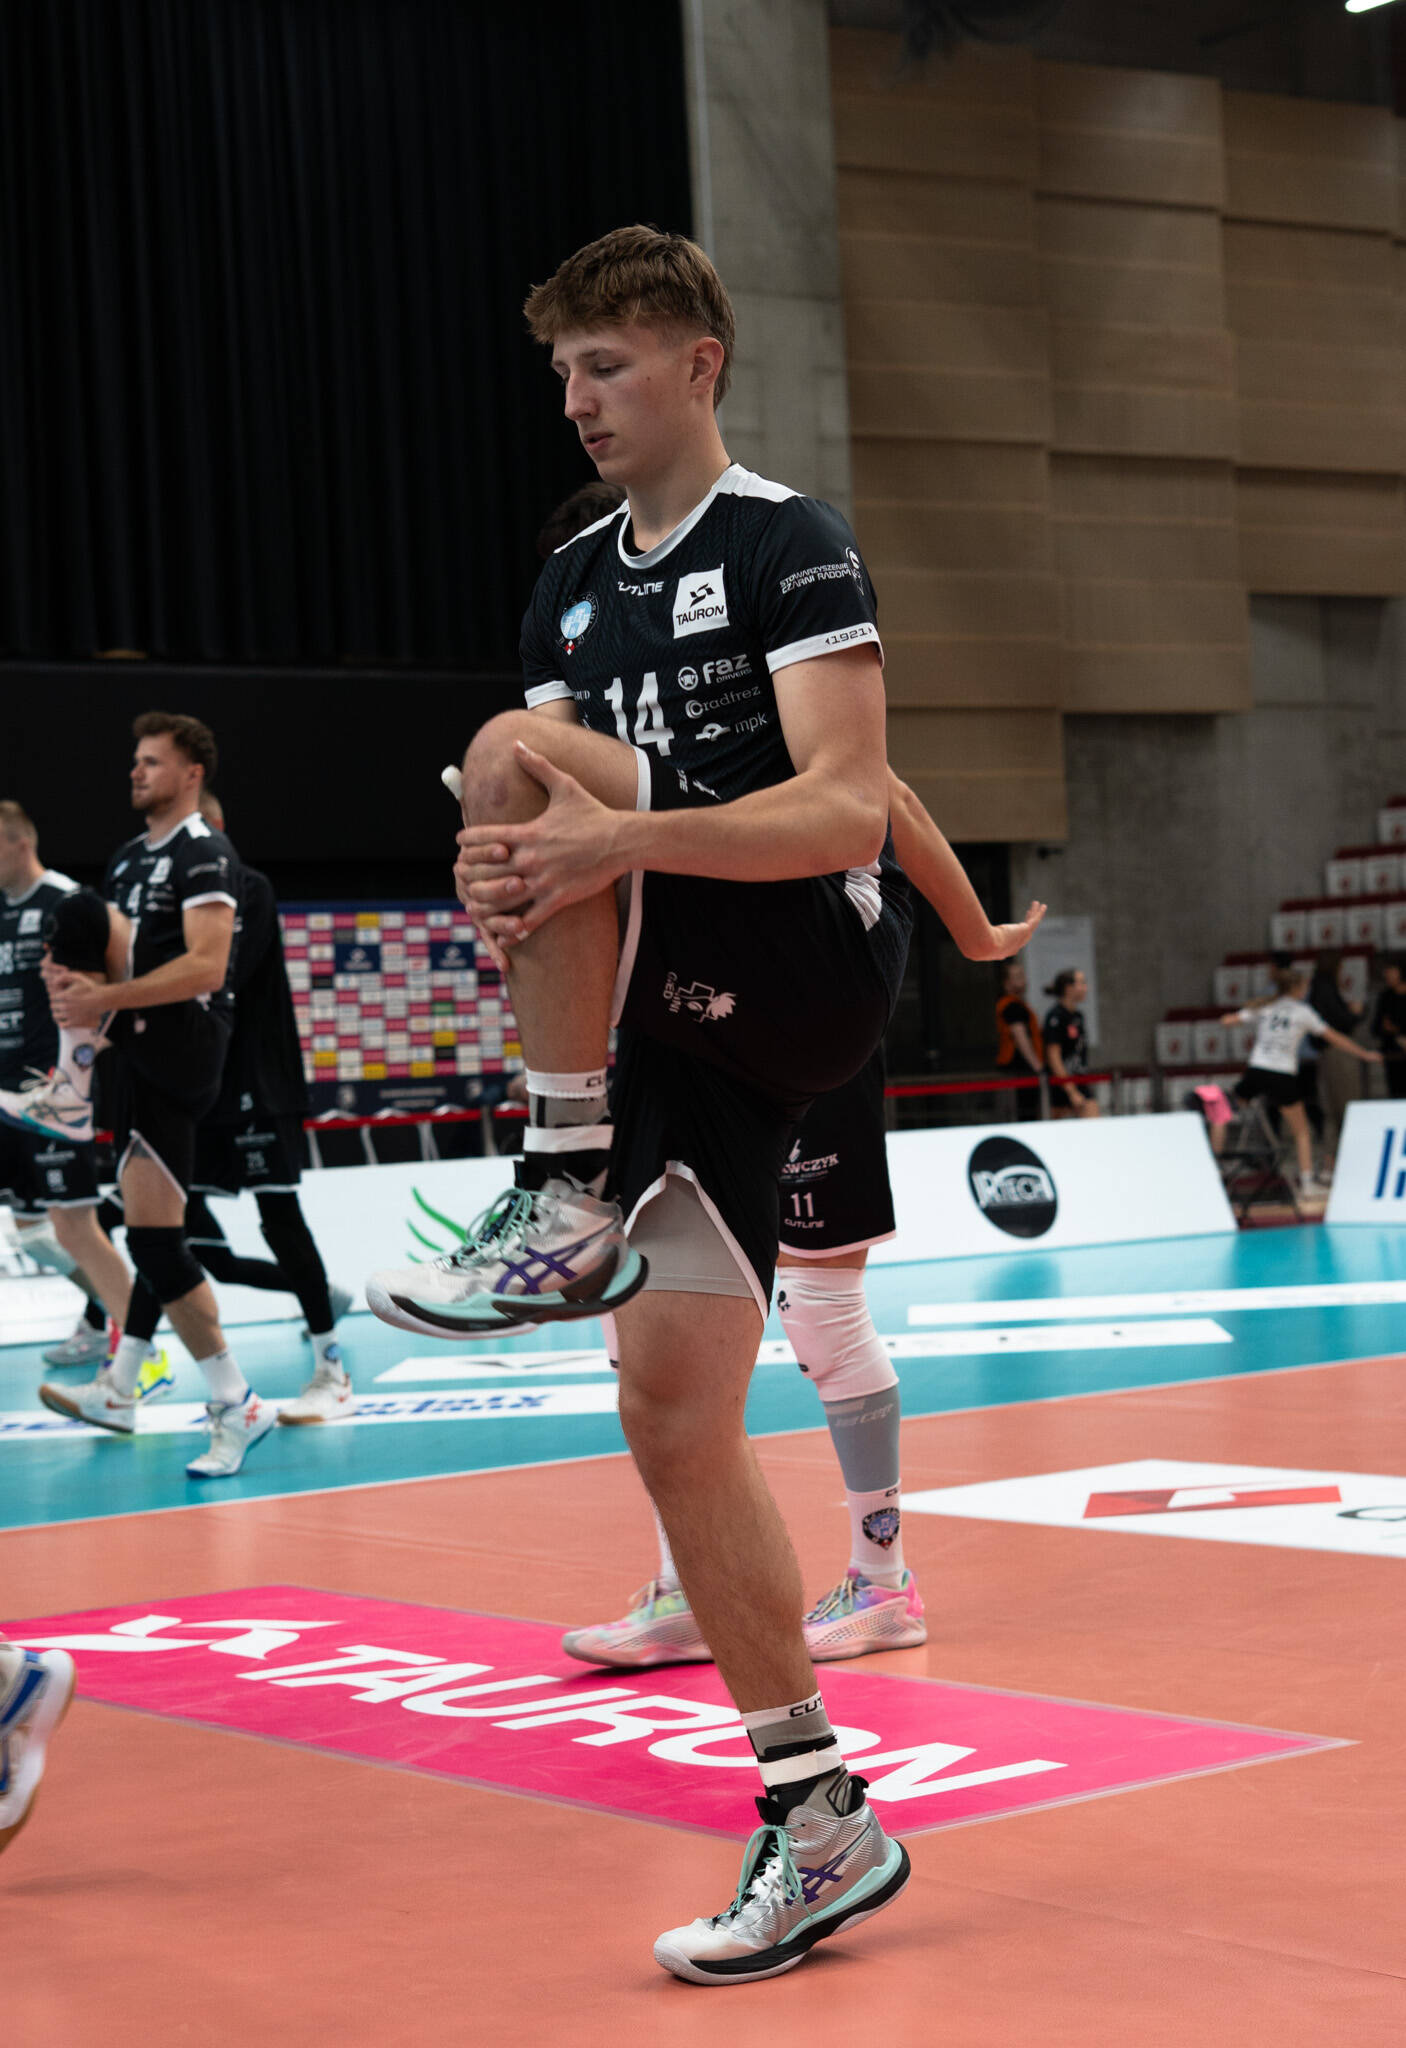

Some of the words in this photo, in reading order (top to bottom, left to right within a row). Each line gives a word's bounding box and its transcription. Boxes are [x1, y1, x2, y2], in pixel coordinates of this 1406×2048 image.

[817, 568, 852, 581] RADOM
[676, 605, 725, 626] TAURON
[831, 627, 868, 645] 1921
[702, 653, 751, 685] faz
[715, 667, 753, 684] DRIVERS
[604, 671, 675, 757] 14
[735, 712, 768, 733] mpk
[791, 1192, 815, 1218] 11
[235, 1645, 1068, 1803] TAURON
